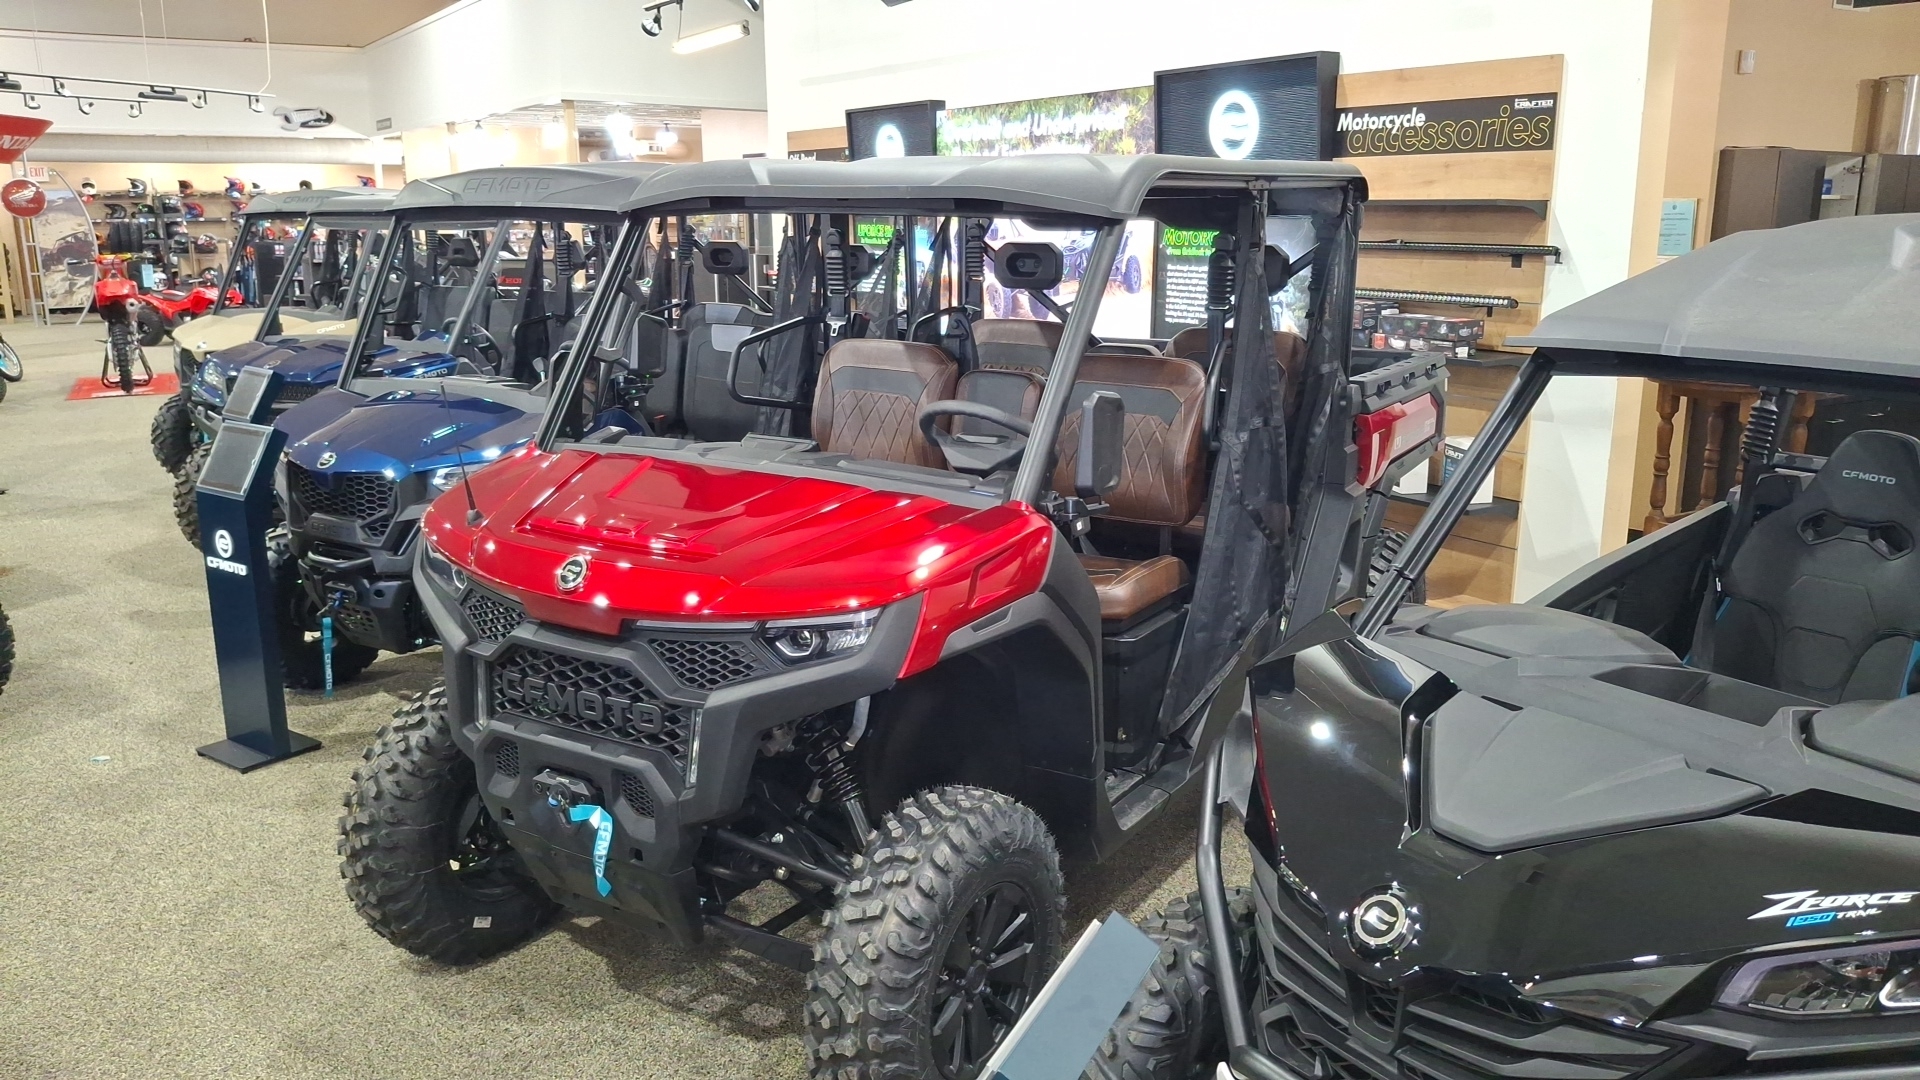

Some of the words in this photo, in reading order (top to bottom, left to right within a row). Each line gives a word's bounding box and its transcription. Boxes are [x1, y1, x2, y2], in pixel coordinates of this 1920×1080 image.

[1336, 106, 1426, 134] Motorcycle
[1347, 104, 1552, 154] accessories
[29, 167, 45, 177] EXIT
[462, 177, 553, 193] CFMOTO
[316, 323, 346, 334] CFMOTO
[1842, 470, 1896, 485] CFMOTO
[206, 556, 248, 576] CFMOTO
[324, 653, 333, 691] CFMOTO
[502, 671, 663, 734] CFMOTO
[594, 821, 611, 878] CFMOTO
[1836, 908, 1882, 919] TRAIL
